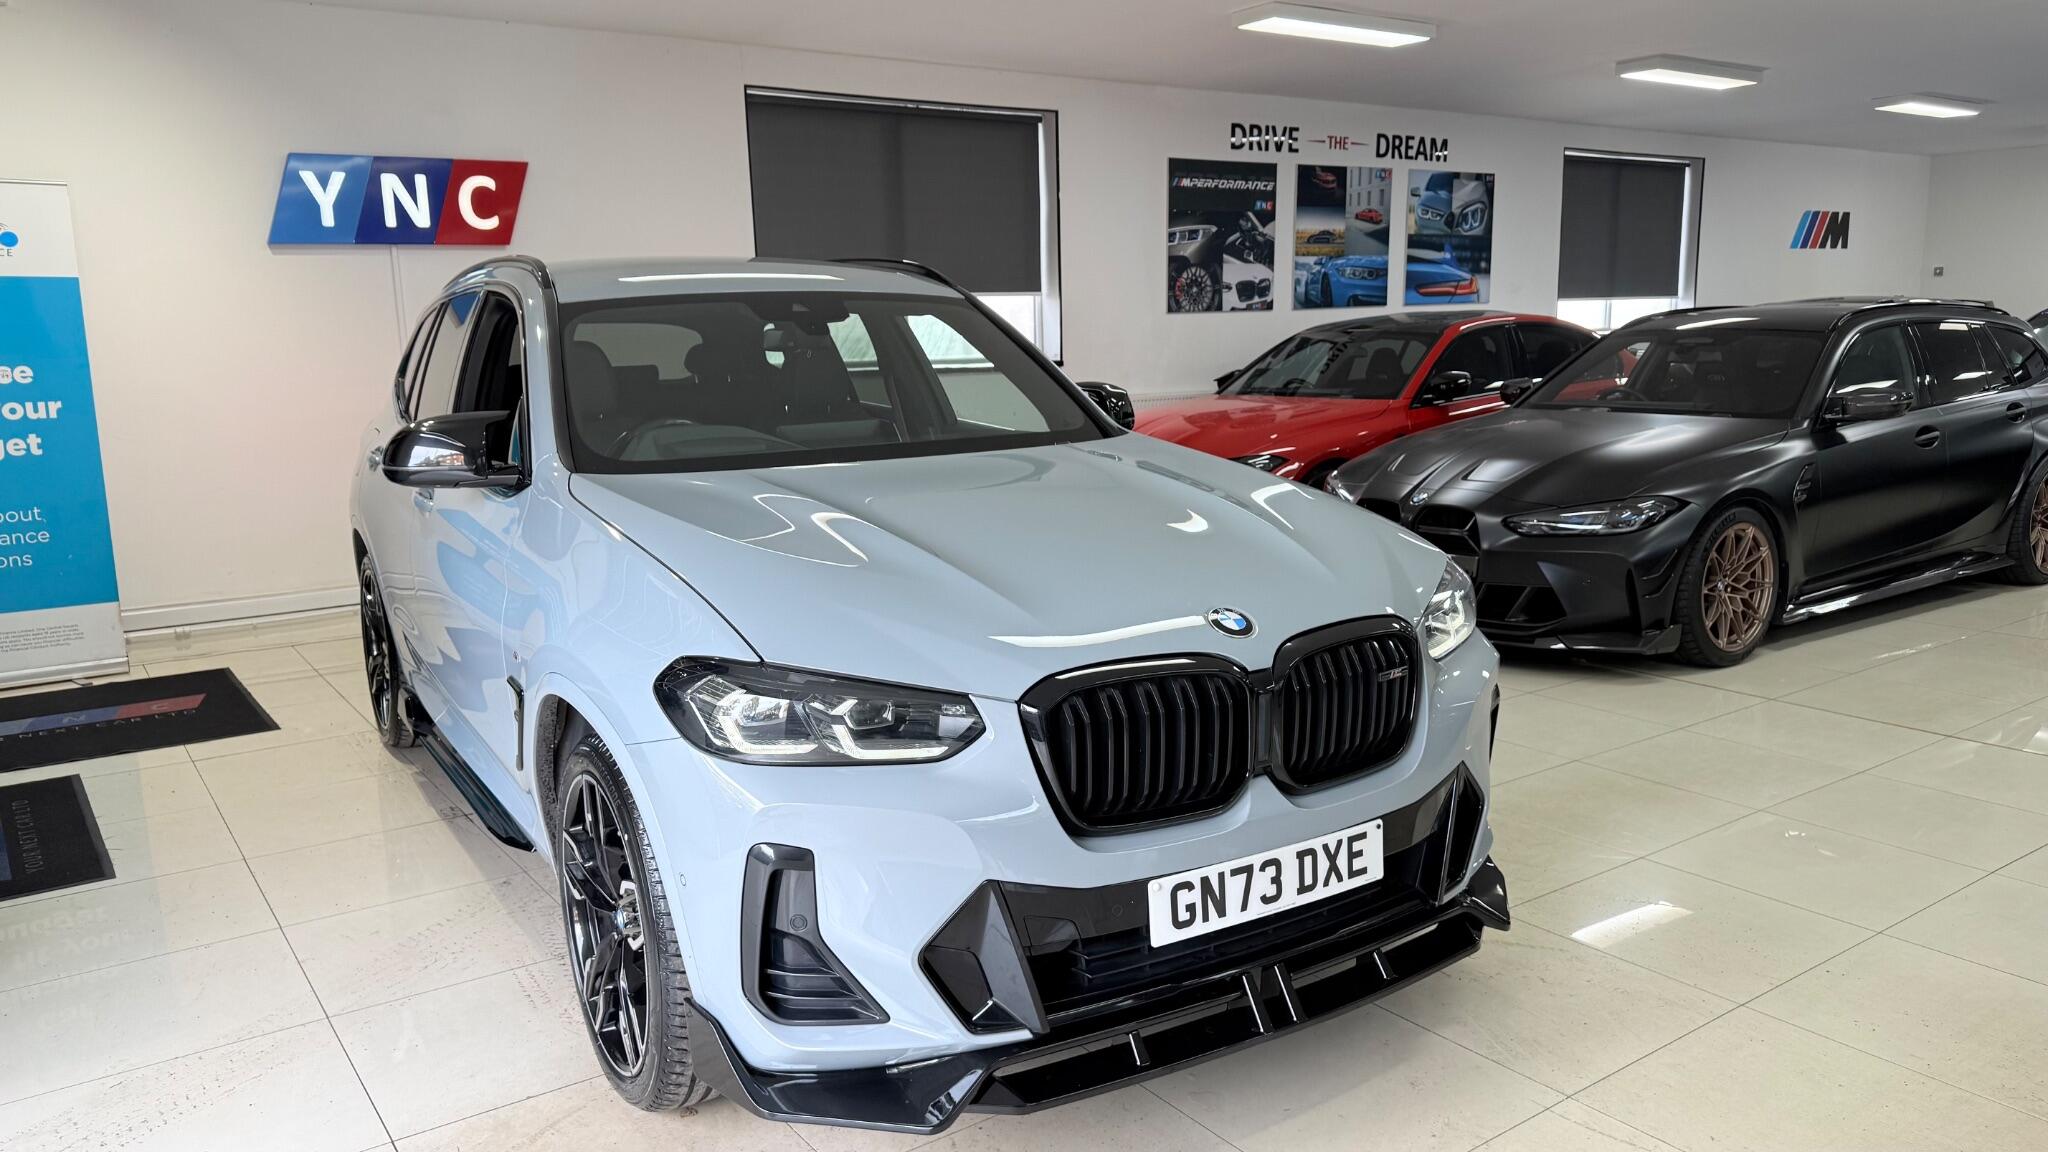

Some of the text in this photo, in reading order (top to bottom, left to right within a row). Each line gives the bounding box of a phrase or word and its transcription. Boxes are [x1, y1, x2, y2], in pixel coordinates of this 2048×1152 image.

[1230, 123, 1448, 162] DRIVE THE DREAM
[298, 170, 500, 230] YNC
[0, 400, 62, 420] our
[0, 433, 43, 460] et
[1170, 831, 1368, 930] GN73 DXE
